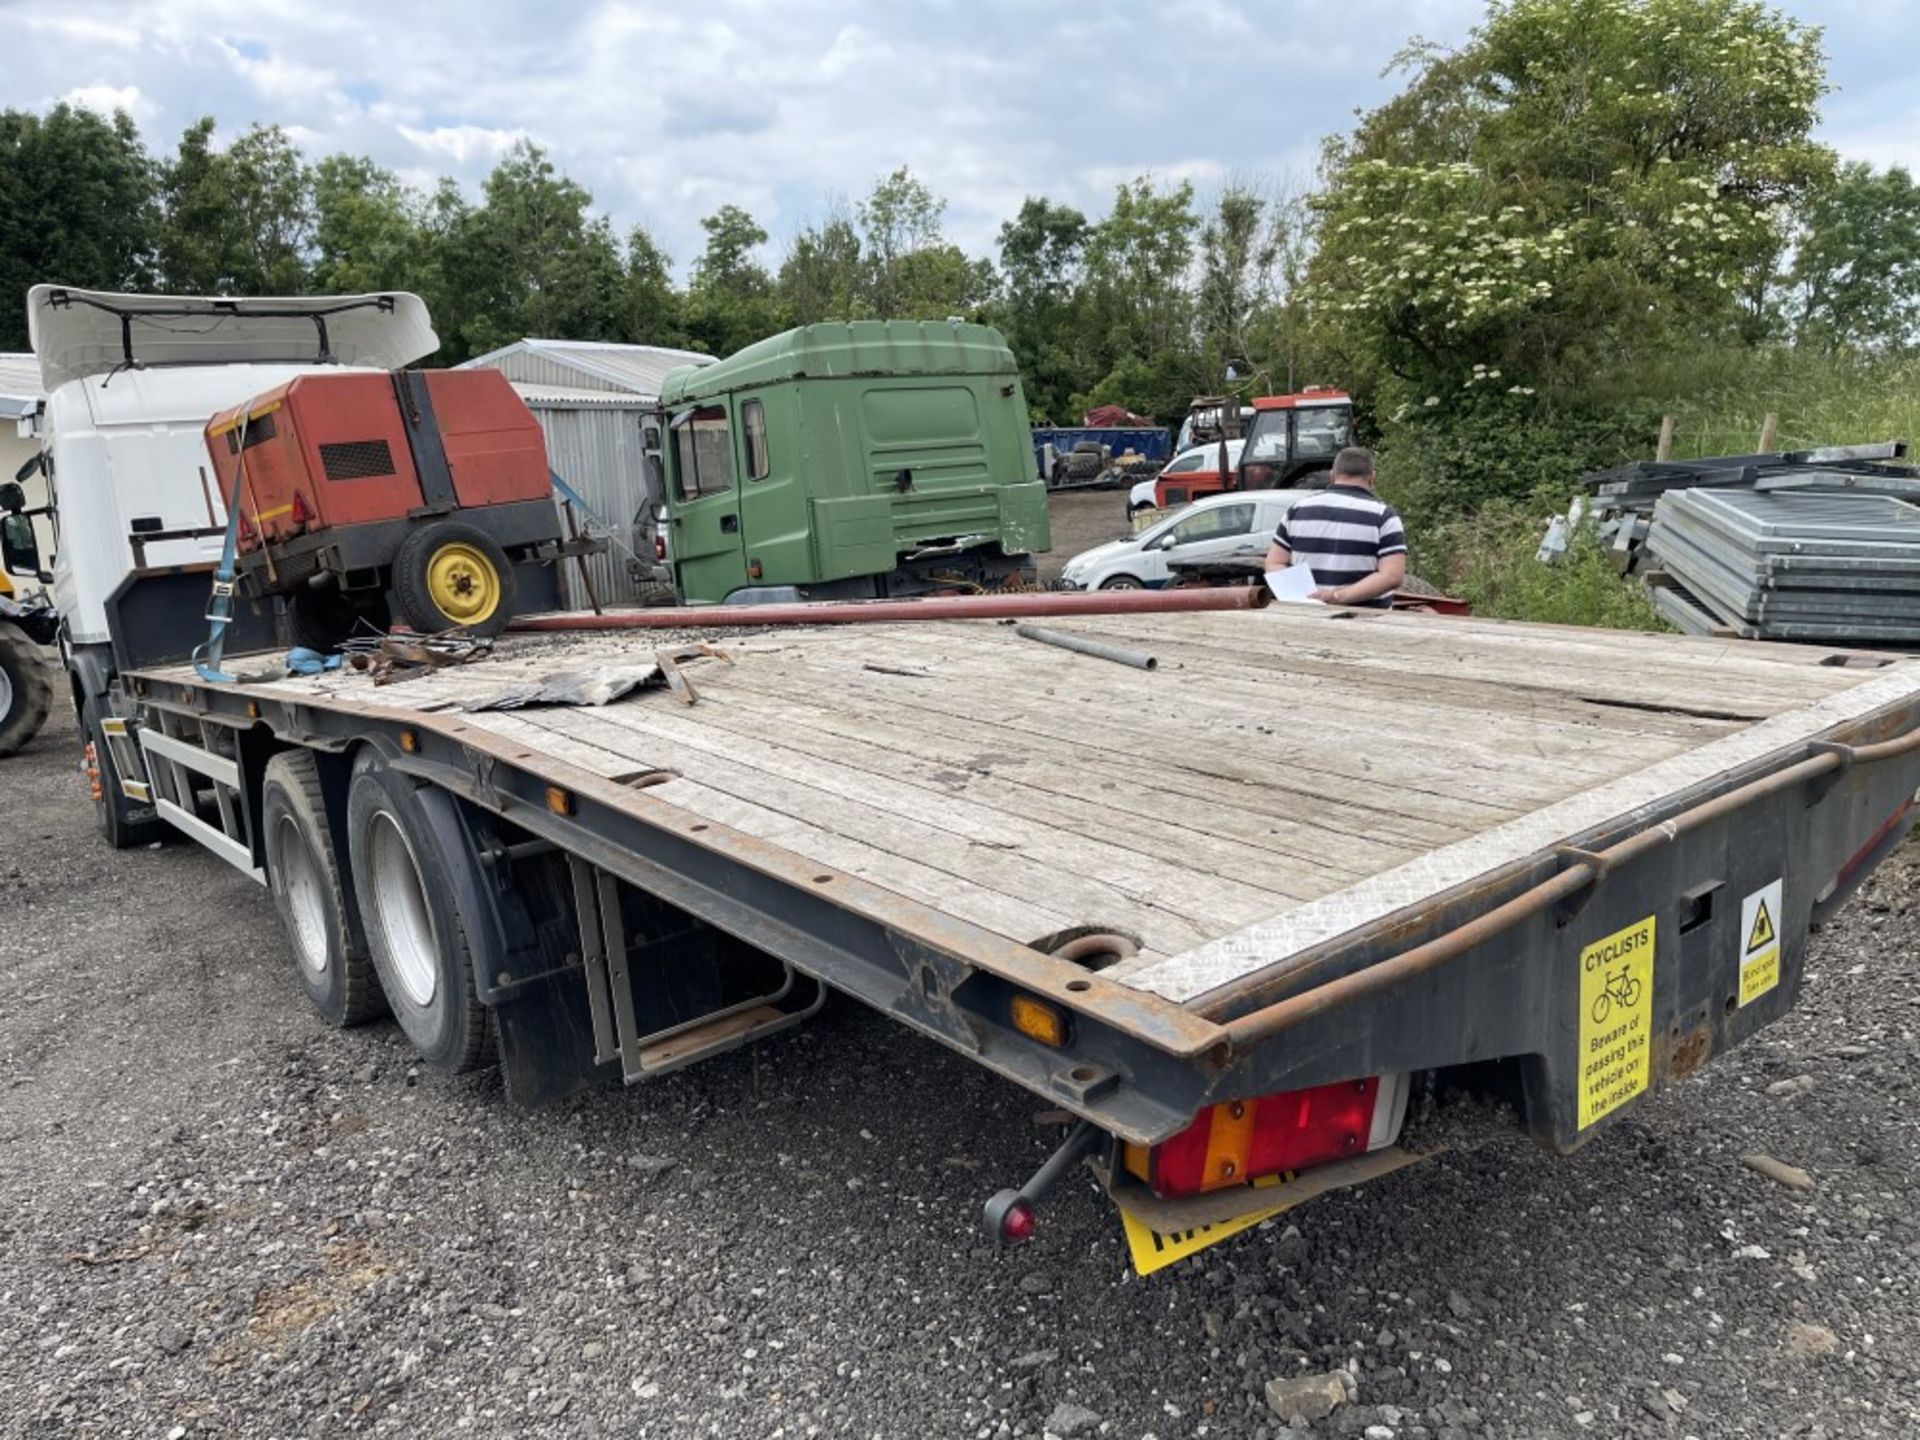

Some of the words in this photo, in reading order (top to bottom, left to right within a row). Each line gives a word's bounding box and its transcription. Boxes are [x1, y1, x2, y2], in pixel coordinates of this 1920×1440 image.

[1585, 929, 1649, 972] CYCLISTS
[1591, 1024, 1627, 1053] Beware
[1629, 1013, 1640, 1031] of
[1586, 1046, 1625, 1080] passing
[1627, 1033, 1645, 1053] this
[1589, 1066, 1624, 1095] vehicle
[1626, 1058, 1639, 1074] on
[1591, 1098, 1607, 1116] the
[1609, 1079, 1639, 1105] inside
